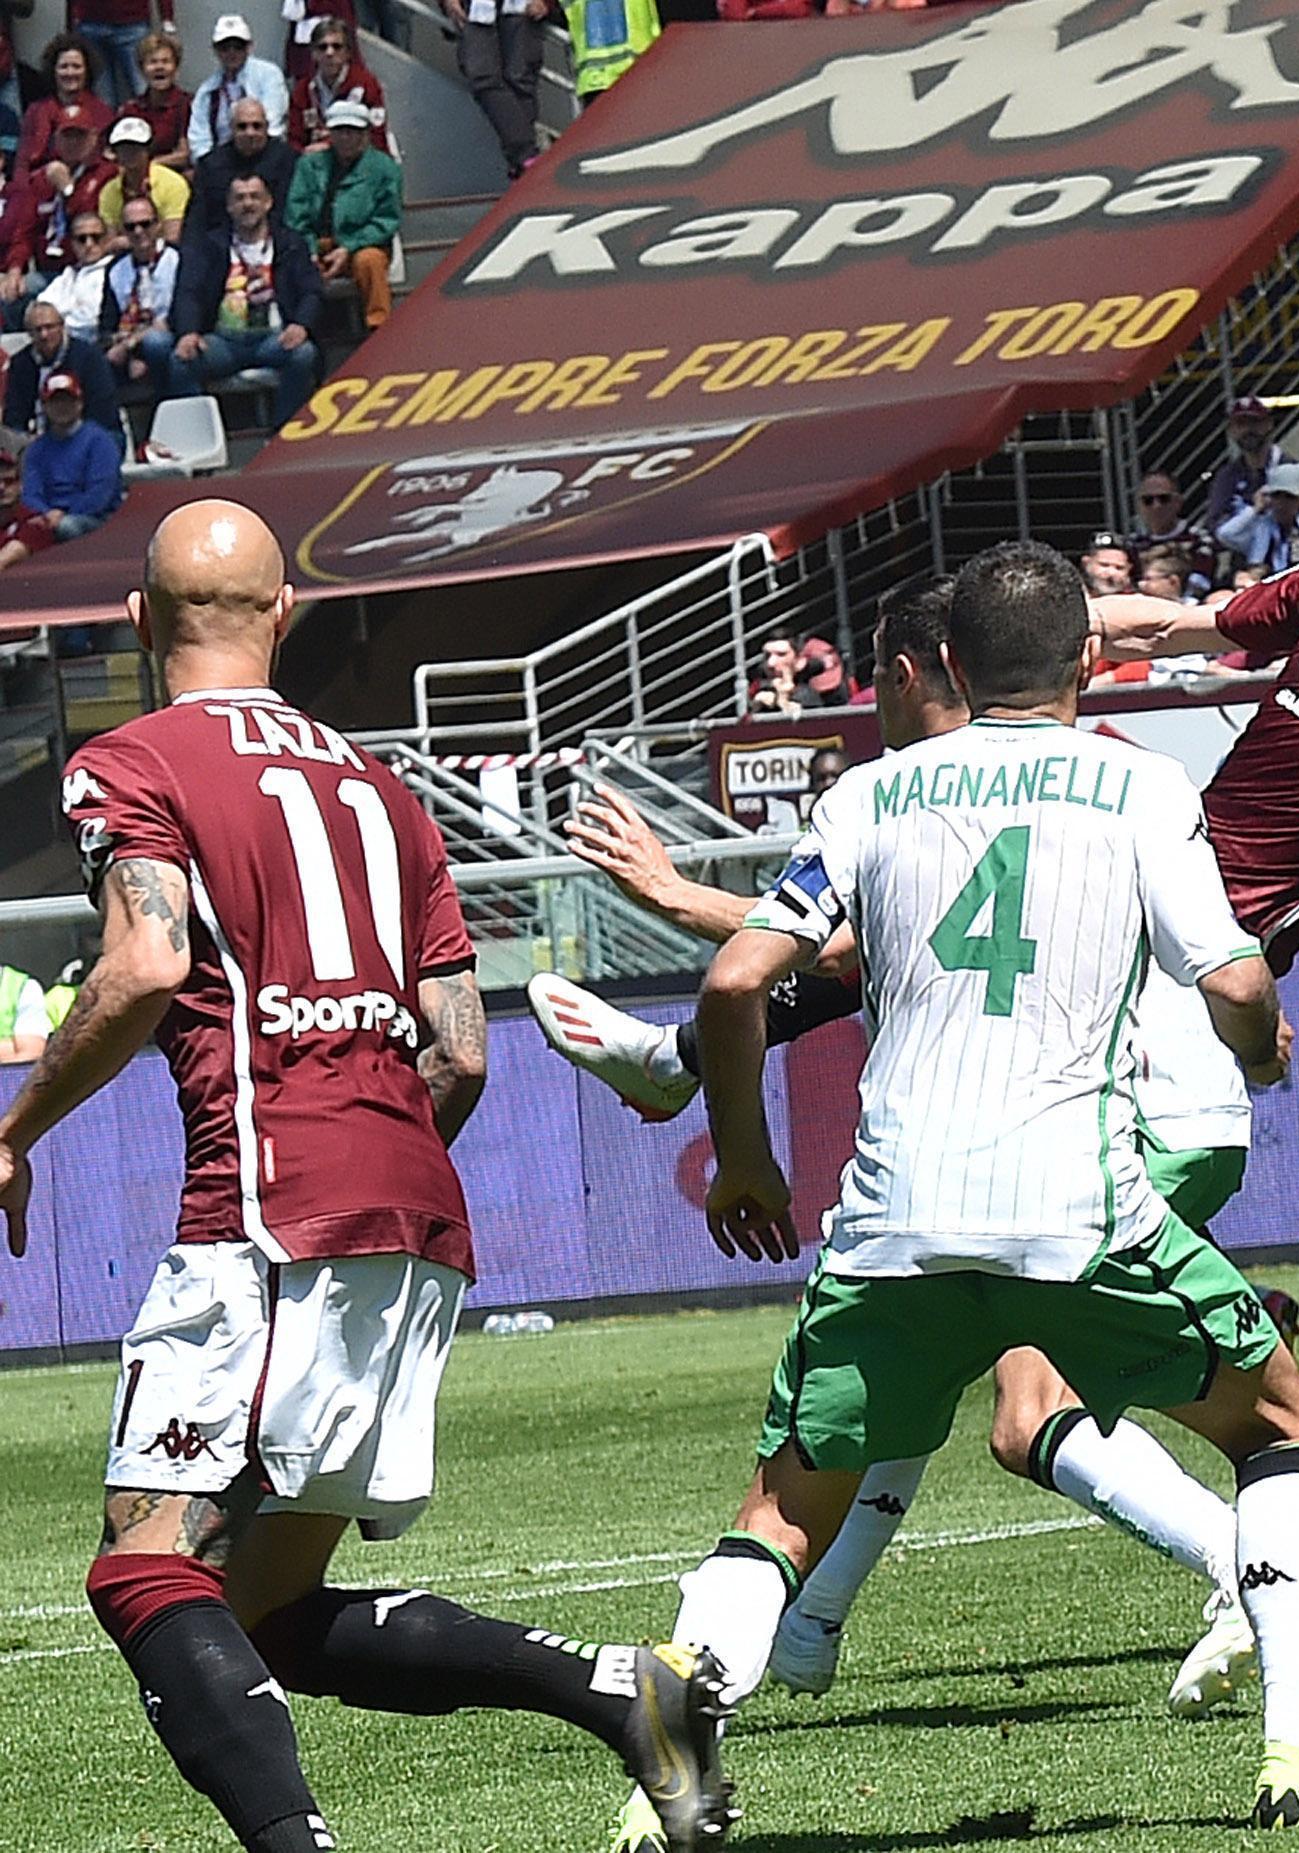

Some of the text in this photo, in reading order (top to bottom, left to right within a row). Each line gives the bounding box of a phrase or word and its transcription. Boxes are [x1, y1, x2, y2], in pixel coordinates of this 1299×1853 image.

[463, 155, 1263, 285] Kappa
[280, 288, 1201, 442] SEMPRE FORZA TORO
[572, 448, 695, 489] FC
[204, 704, 367, 772] ZAZA
[873, 756, 1131, 825] MAGNANELLI
[257, 765, 405, 992] 11
[928, 825, 1037, 1017] 4
